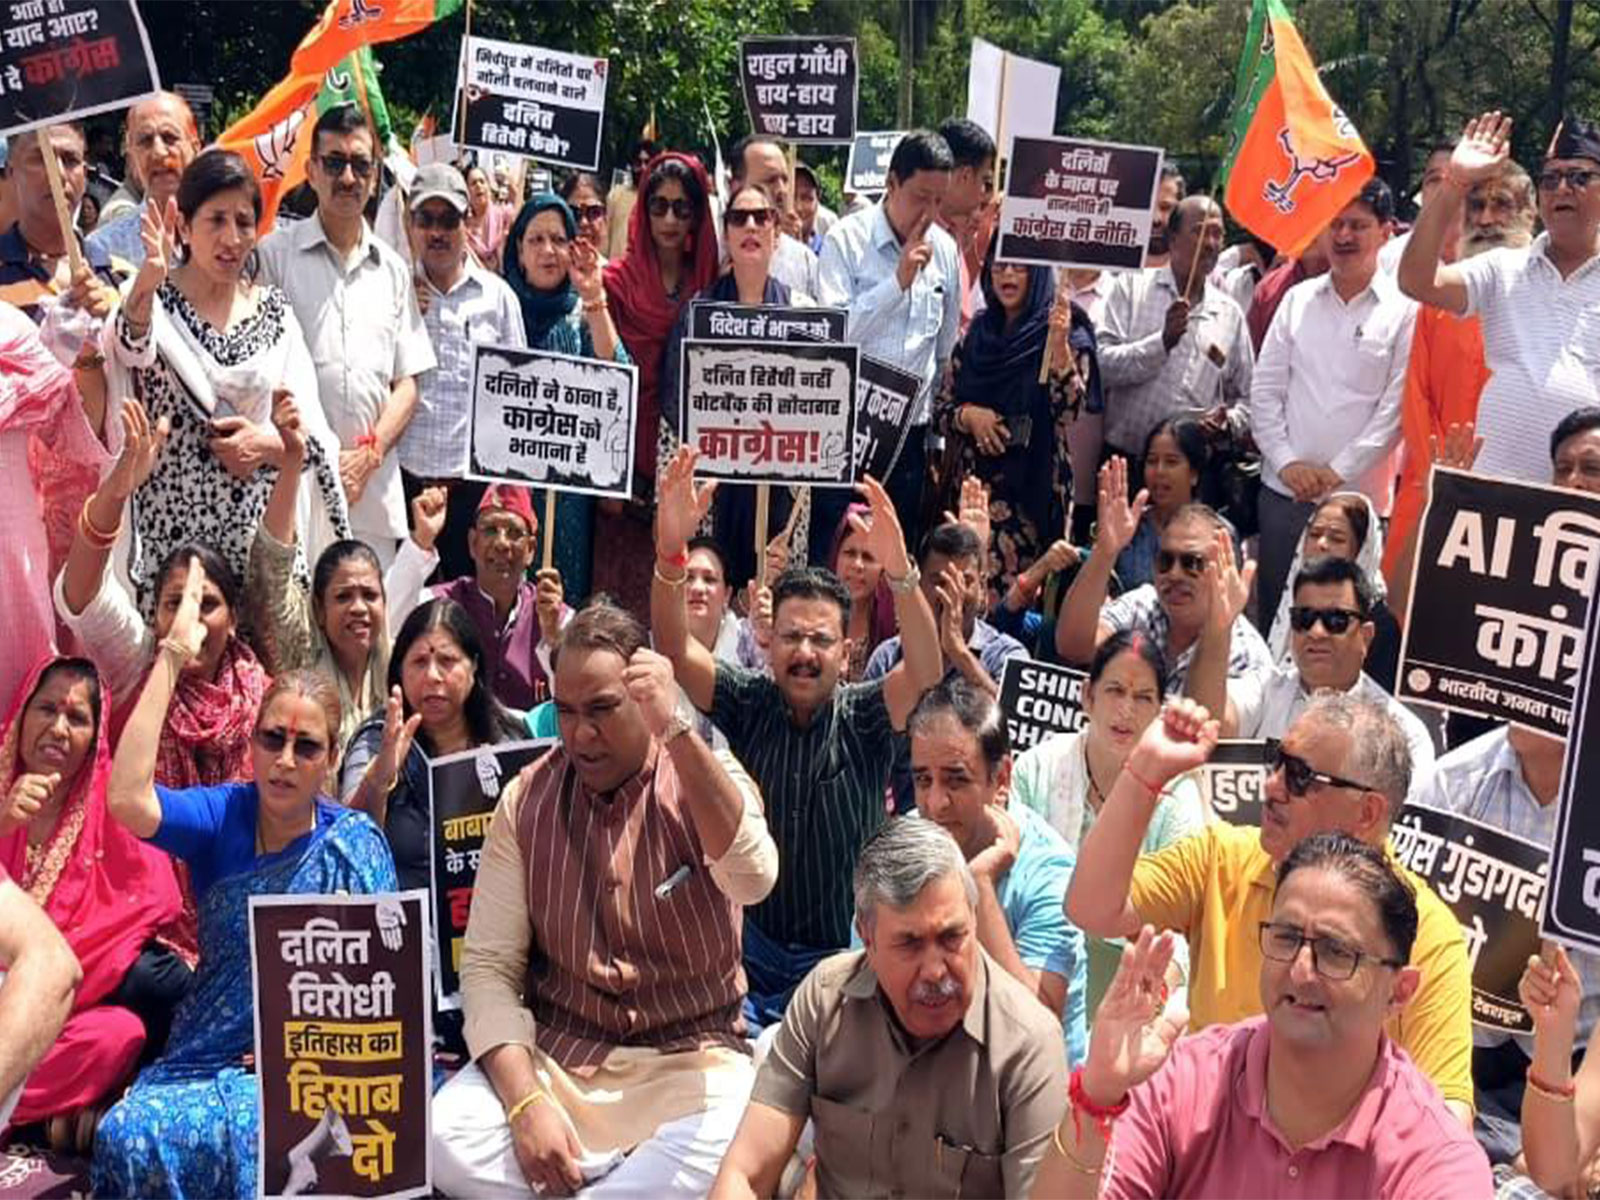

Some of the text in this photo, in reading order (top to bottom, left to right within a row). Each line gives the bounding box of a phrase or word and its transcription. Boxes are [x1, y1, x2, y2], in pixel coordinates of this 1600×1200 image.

[3, 8, 99, 48] याद आए?
[5, 64, 23, 91] दे
[20, 36, 120, 84] कांग्रेस
[577, 67, 592, 81] पर
[747, 43, 848, 80] राहुल गाँधी
[755, 84, 837, 105] हाय-हाय
[503, 101, 554, 129] दलित
[1061, 148, 1111, 174] दलितों
[1045, 168, 1119, 196] के नाम पर
[1013, 213, 1137, 246] कांग्रेस की नीति!
[709, 311, 748, 336] विदेश
[750, 314, 768, 337] में
[484, 372, 540, 399] दलितों
[543, 378, 560, 402] ने
[564, 385, 604, 408] ठाना
[702, 364, 745, 386] दलित
[800, 367, 835, 388] नहीं
[503, 401, 602, 441] कांग्रेस को
[752, 393, 772, 413] की
[777, 394, 841, 415] सौदागर
[509, 437, 588, 464] भगाना है
[697, 419, 820, 465] कांग्रेस!
[1437, 510, 1516, 579] AI
[1438, 678, 1499, 704] भारतीय
[1501, 690, 1549, 718] जनता
[445, 848, 465, 874] के
[278, 918, 371, 966] दलित
[288, 971, 396, 1018] विरोधी
[288, 1025, 398, 1057] इतिहास का
[287, 1060, 403, 1120] हिसाब
[350, 1119, 396, 1181] दो
